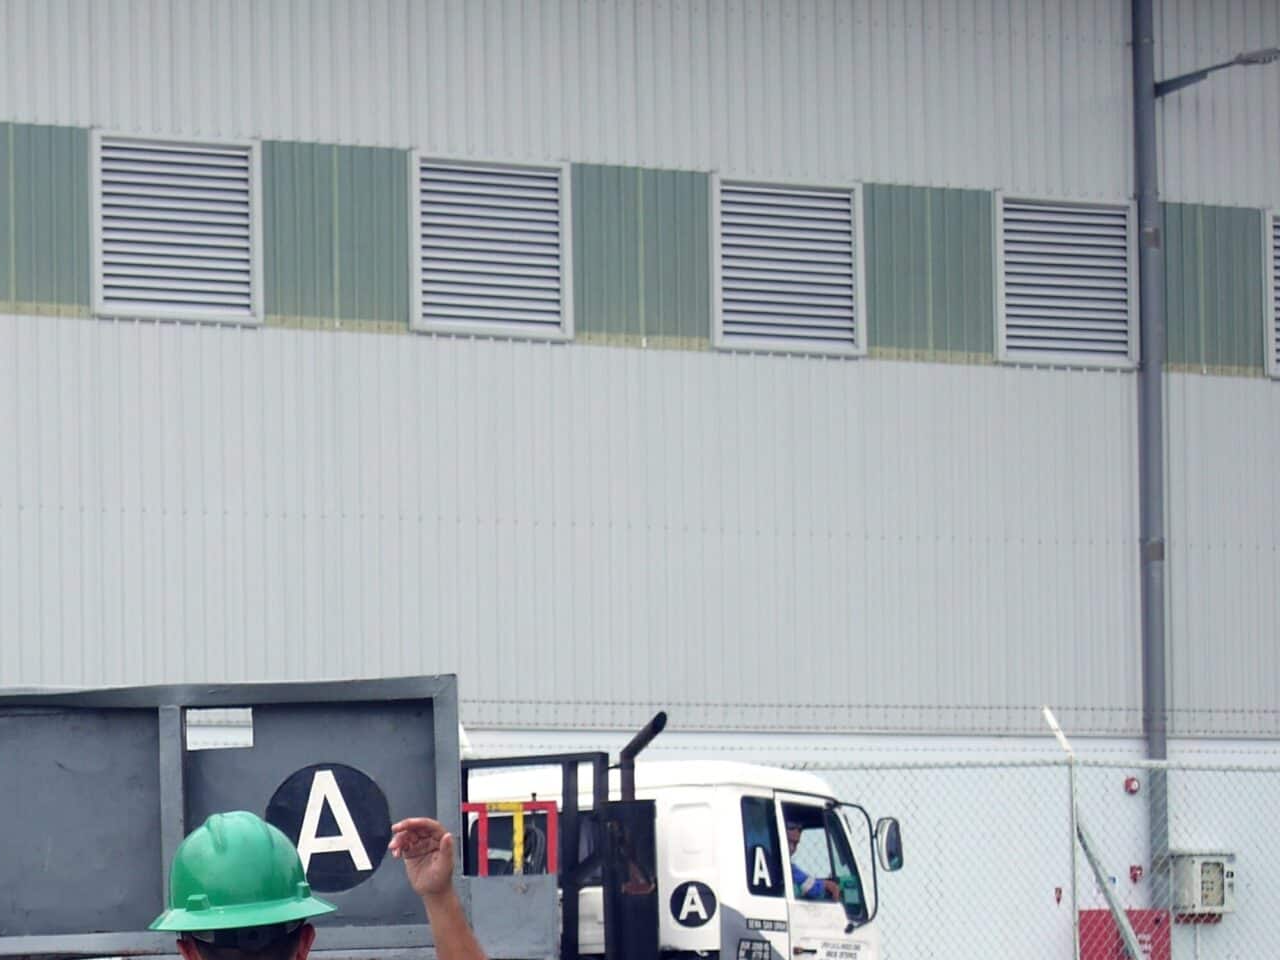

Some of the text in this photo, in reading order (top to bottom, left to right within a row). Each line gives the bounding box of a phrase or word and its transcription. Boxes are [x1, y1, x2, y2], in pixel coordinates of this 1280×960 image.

[297, 769, 374, 882] A
[753, 846, 772, 887] A
[679, 885, 709, 920] A
